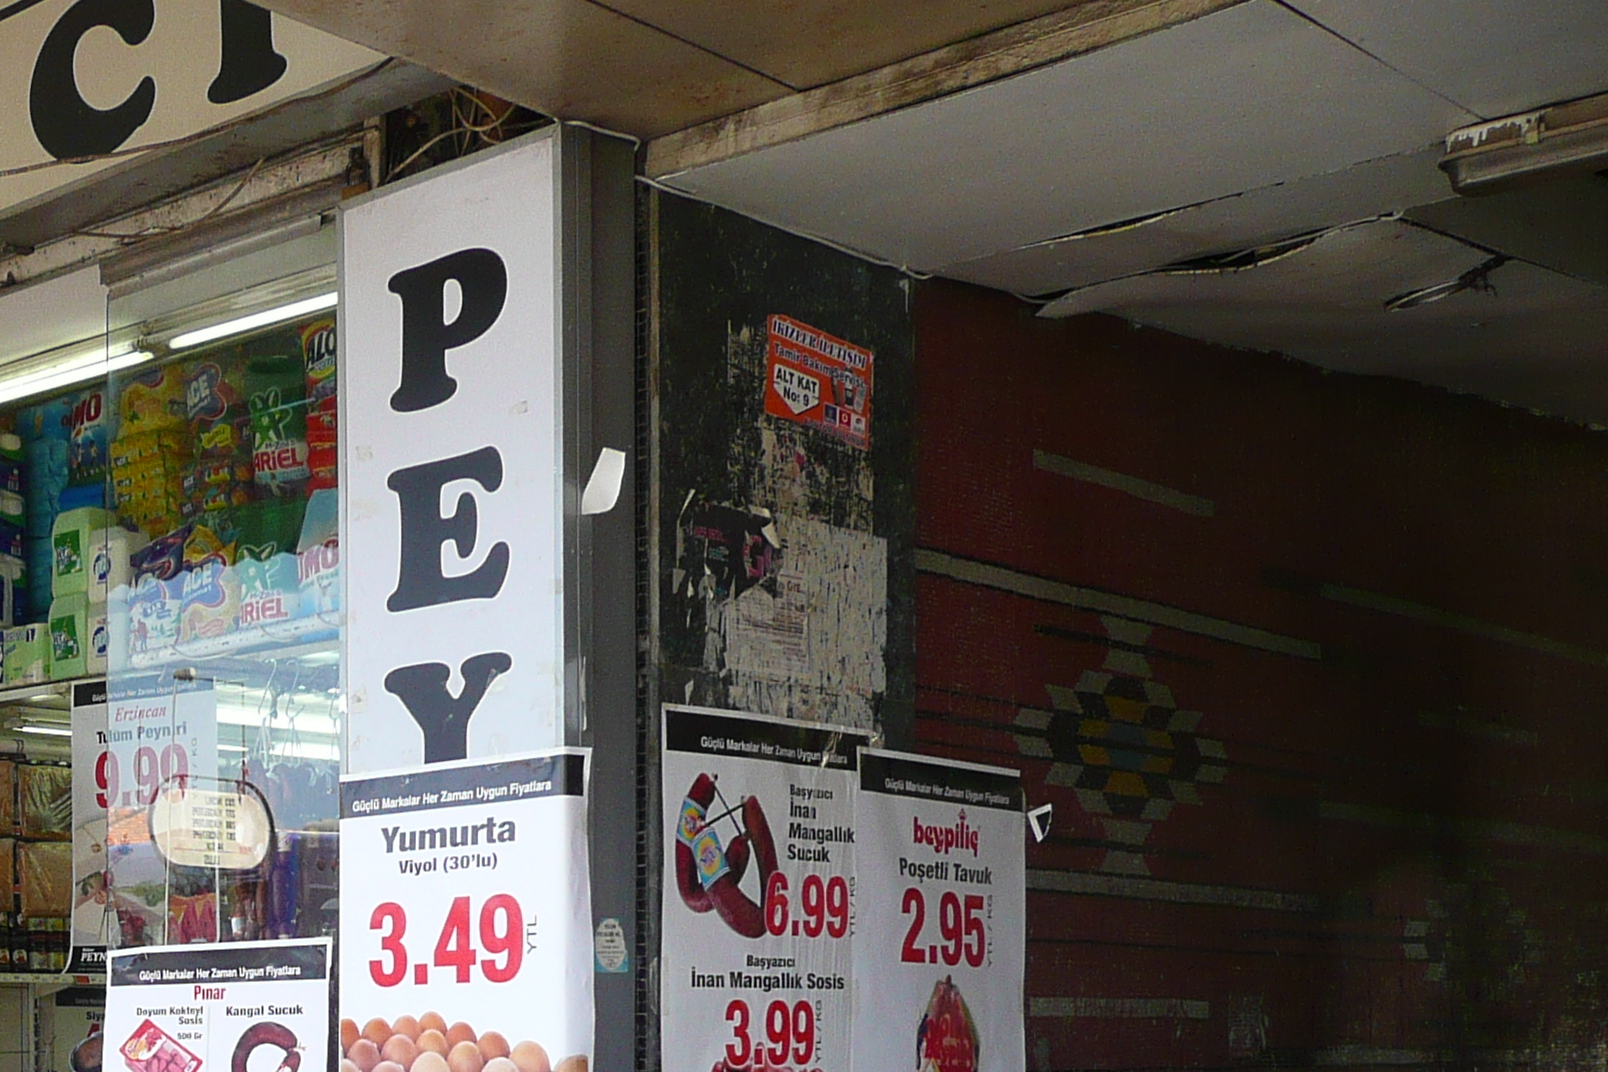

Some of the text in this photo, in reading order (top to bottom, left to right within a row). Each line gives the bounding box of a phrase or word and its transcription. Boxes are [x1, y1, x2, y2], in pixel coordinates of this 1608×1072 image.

[774, 342, 802, 364] Tamir
[775, 366, 818, 394] ALT KAT
[802, 394, 810, 408] 9
[114, 703, 167, 724] Erzincan
[95, 721, 188, 745] Tulum Peyniri
[700, 735, 726, 752] Güçlü
[726, 738, 761, 754] Markalar
[761, 742, 775, 755] Her
[94, 743, 189, 810] 9.99
[352, 779, 553, 814] Güçlü Markalar Her Zaman Uygun Fiyatlara
[790, 797, 817, 820] İnan
[380, 816, 517, 854] Yumurta
[788, 822, 856, 845] Mangallık
[787, 844, 831, 864] Sucuk
[398, 858, 438, 876] Viyol
[898, 857, 993, 885] Poşetli Tavuk
[765, 870, 850, 939] 6.99
[900, 887, 987, 968] 2.95
[368, 893, 525, 988] 3.49
[525, 914, 538, 955] YTL
[746, 954, 796, 972] Başyazıcı
[691, 966, 846, 994] İnan Mangallık Sosis
[193, 985, 227, 1001] Pınar
[136, 1005, 204, 1018] Doyum Kokteyl
[178, 1016, 204, 1025] Sosis
[226, 1004, 304, 1019] Kangal Sucuk
[725, 999, 816, 1068] 3.99
